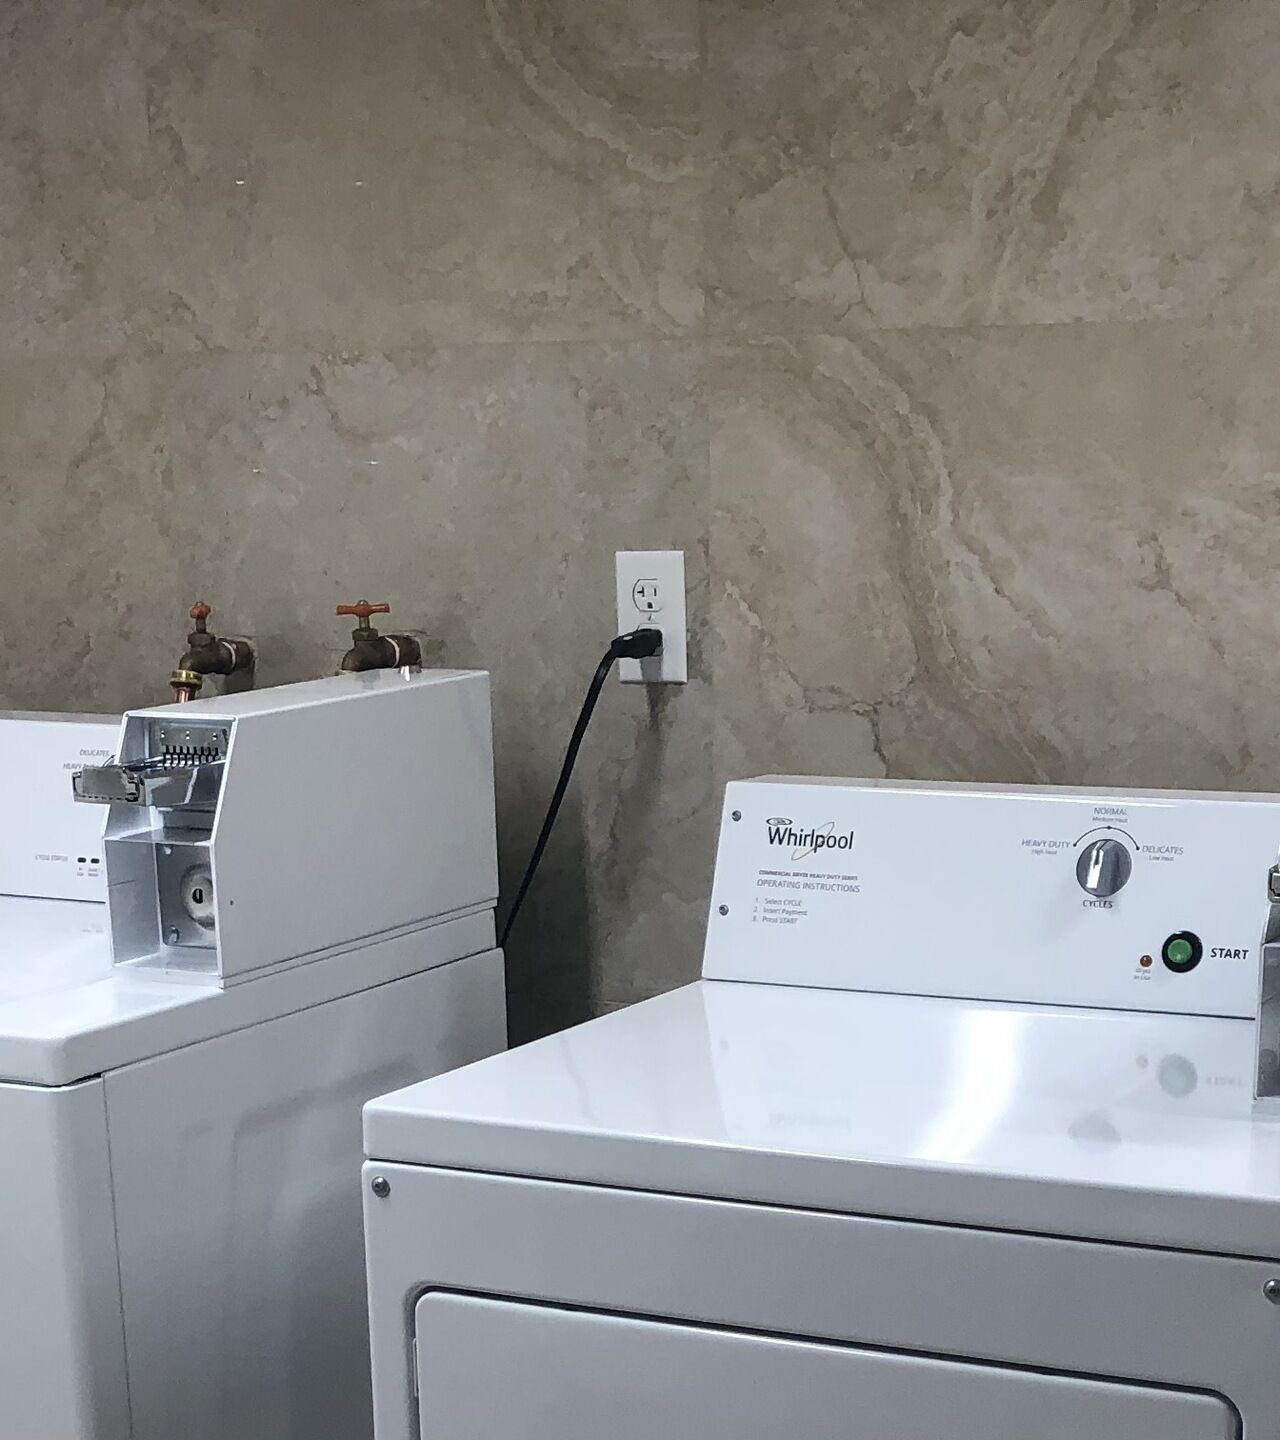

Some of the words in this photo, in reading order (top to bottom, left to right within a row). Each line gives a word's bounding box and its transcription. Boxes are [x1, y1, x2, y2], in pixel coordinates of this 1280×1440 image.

[1094, 807, 1128, 816] NORMAL
[768, 826, 854, 853] Whirlpool
[1022, 839, 1047, 848] HEAVY
[1048, 840, 1070, 849] DUTY
[1142, 845, 1184, 855] DELICATES
[757, 879, 801, 889] OPERATING
[802, 882, 860, 893] INSTRUCTIONS
[1082, 900, 1113, 908] CYCLES
[782, 908, 808, 916] Payment
[1211, 948, 1249, 960] START
